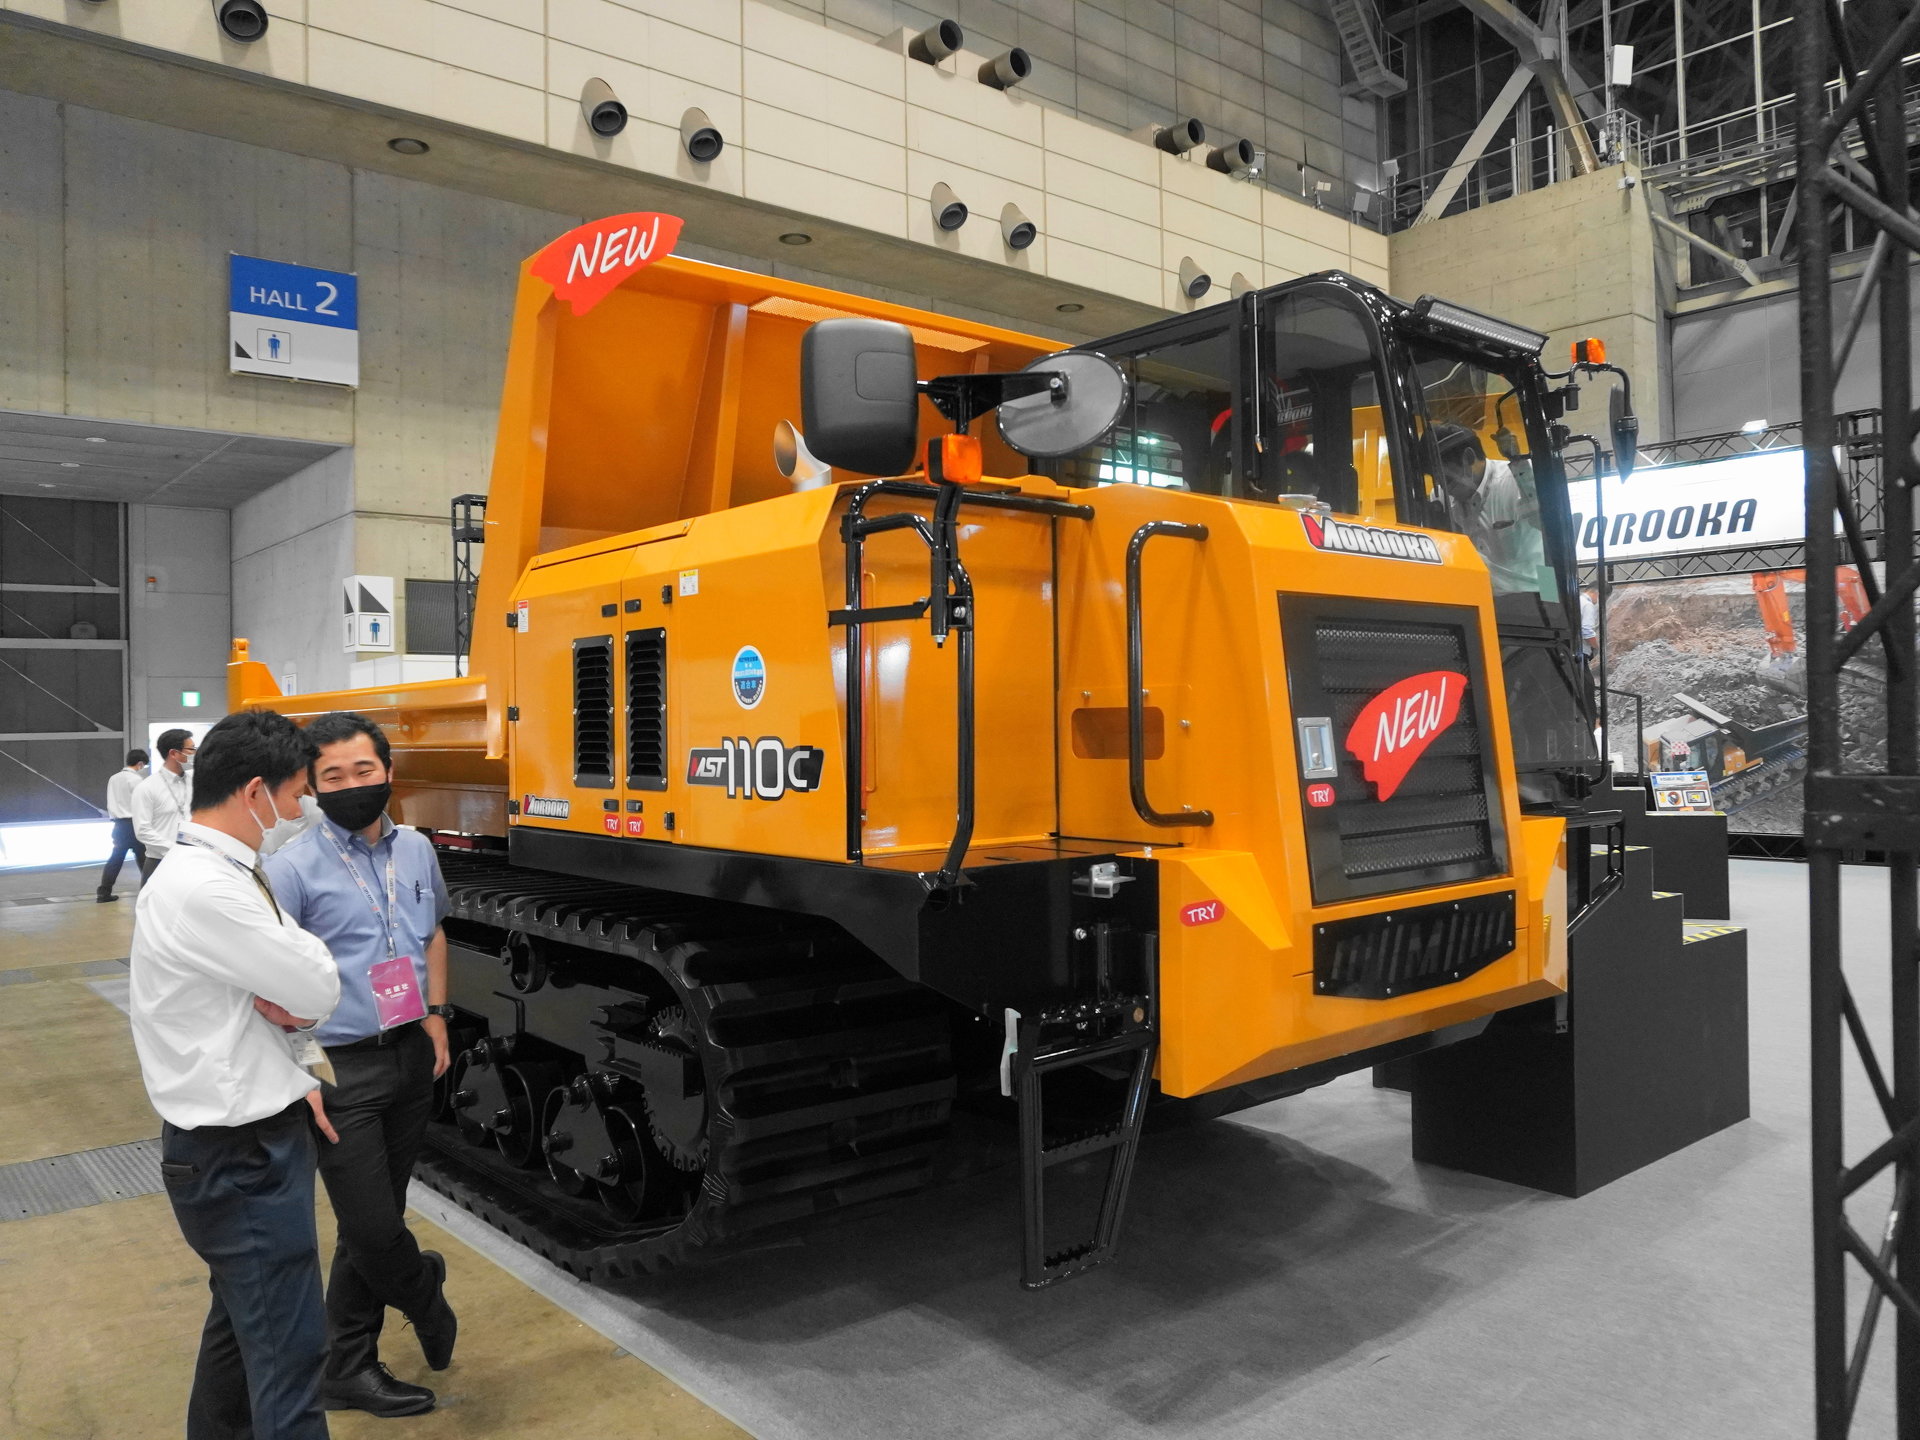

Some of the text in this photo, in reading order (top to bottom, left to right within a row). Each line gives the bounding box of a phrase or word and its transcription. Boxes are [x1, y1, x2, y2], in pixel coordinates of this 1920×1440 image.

[566, 216, 660, 284] NEW
[250, 281, 339, 316] HALL 2
[1300, 513, 1441, 562] MOROOKA
[1573, 498, 1758, 549] OROOKA
[1373, 676, 1447, 762] NEW
[524, 794, 569, 818] MOROOKA
[1311, 788, 1330, 803] TRY
[606, 818, 619, 831] TRY
[629, 820, 642, 833] TRY
[1187, 903, 1216, 922] TRY
